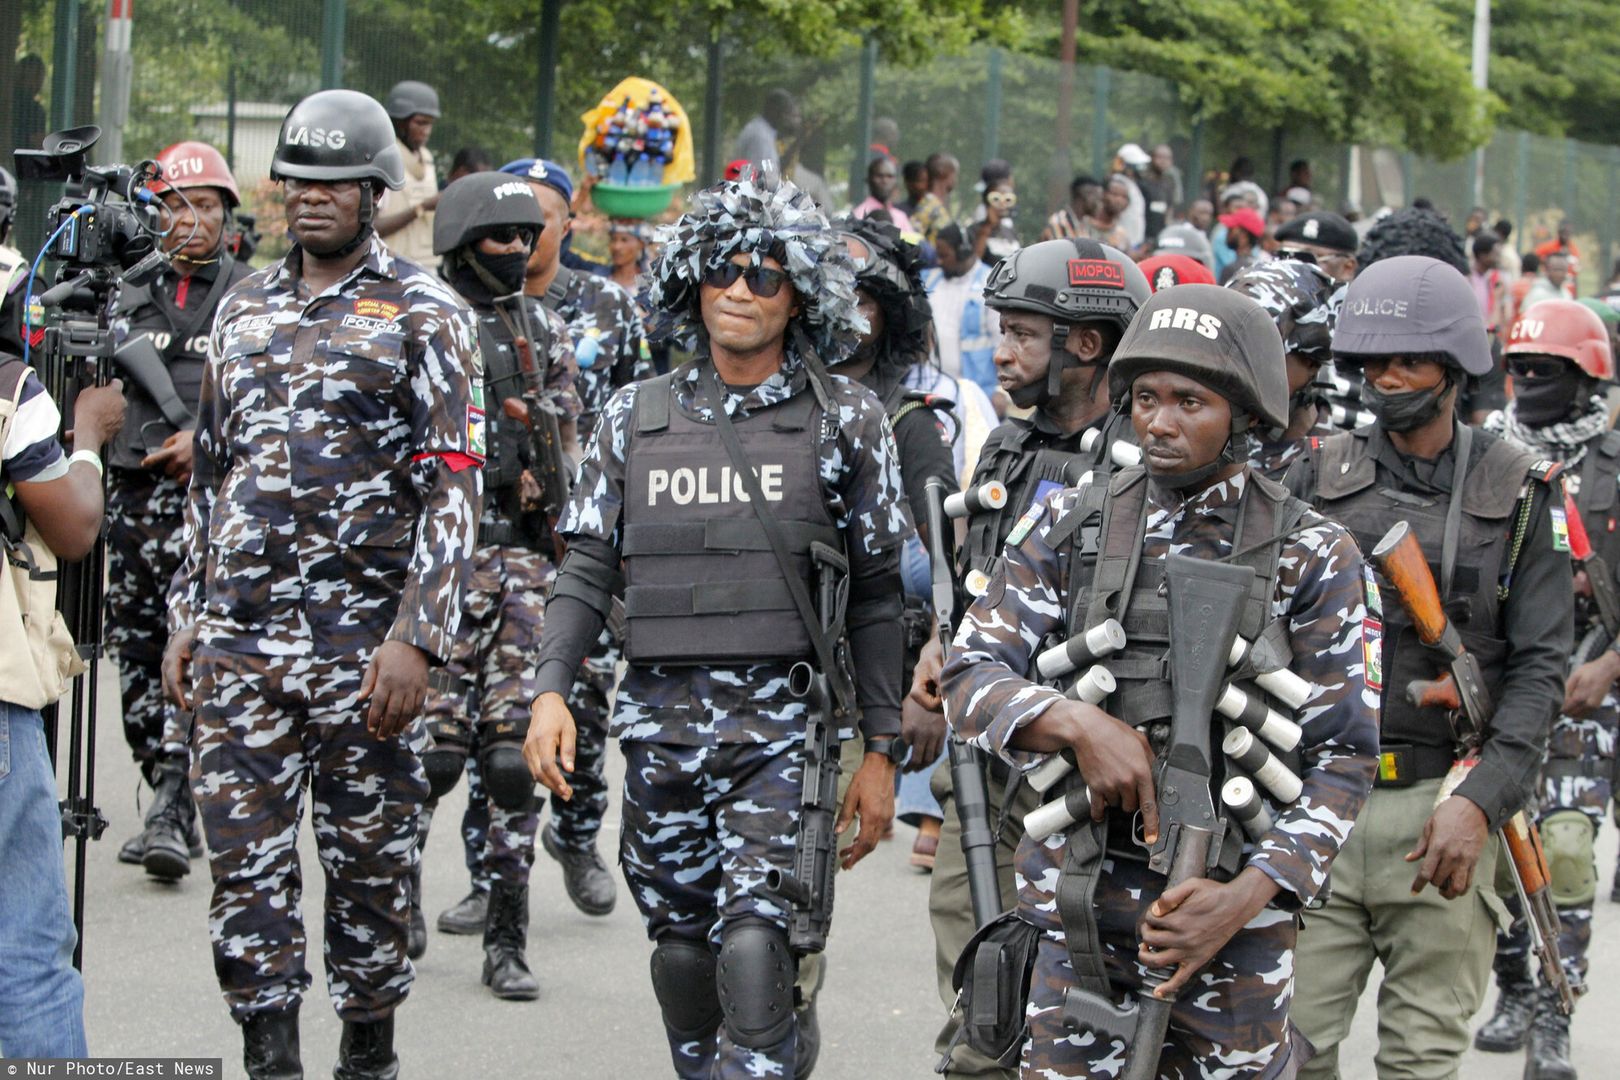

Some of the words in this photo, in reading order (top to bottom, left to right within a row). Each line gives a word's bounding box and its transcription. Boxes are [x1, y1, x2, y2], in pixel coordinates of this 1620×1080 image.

[286, 126, 346, 150] LASG
[168, 157, 203, 180] CTU
[1075, 264, 1120, 279] MOPOL
[1347, 298, 1408, 318] POLICE
[346, 317, 395, 332] POLICE
[1148, 307, 1222, 340] RRS
[648, 464, 783, 506] POLICE
